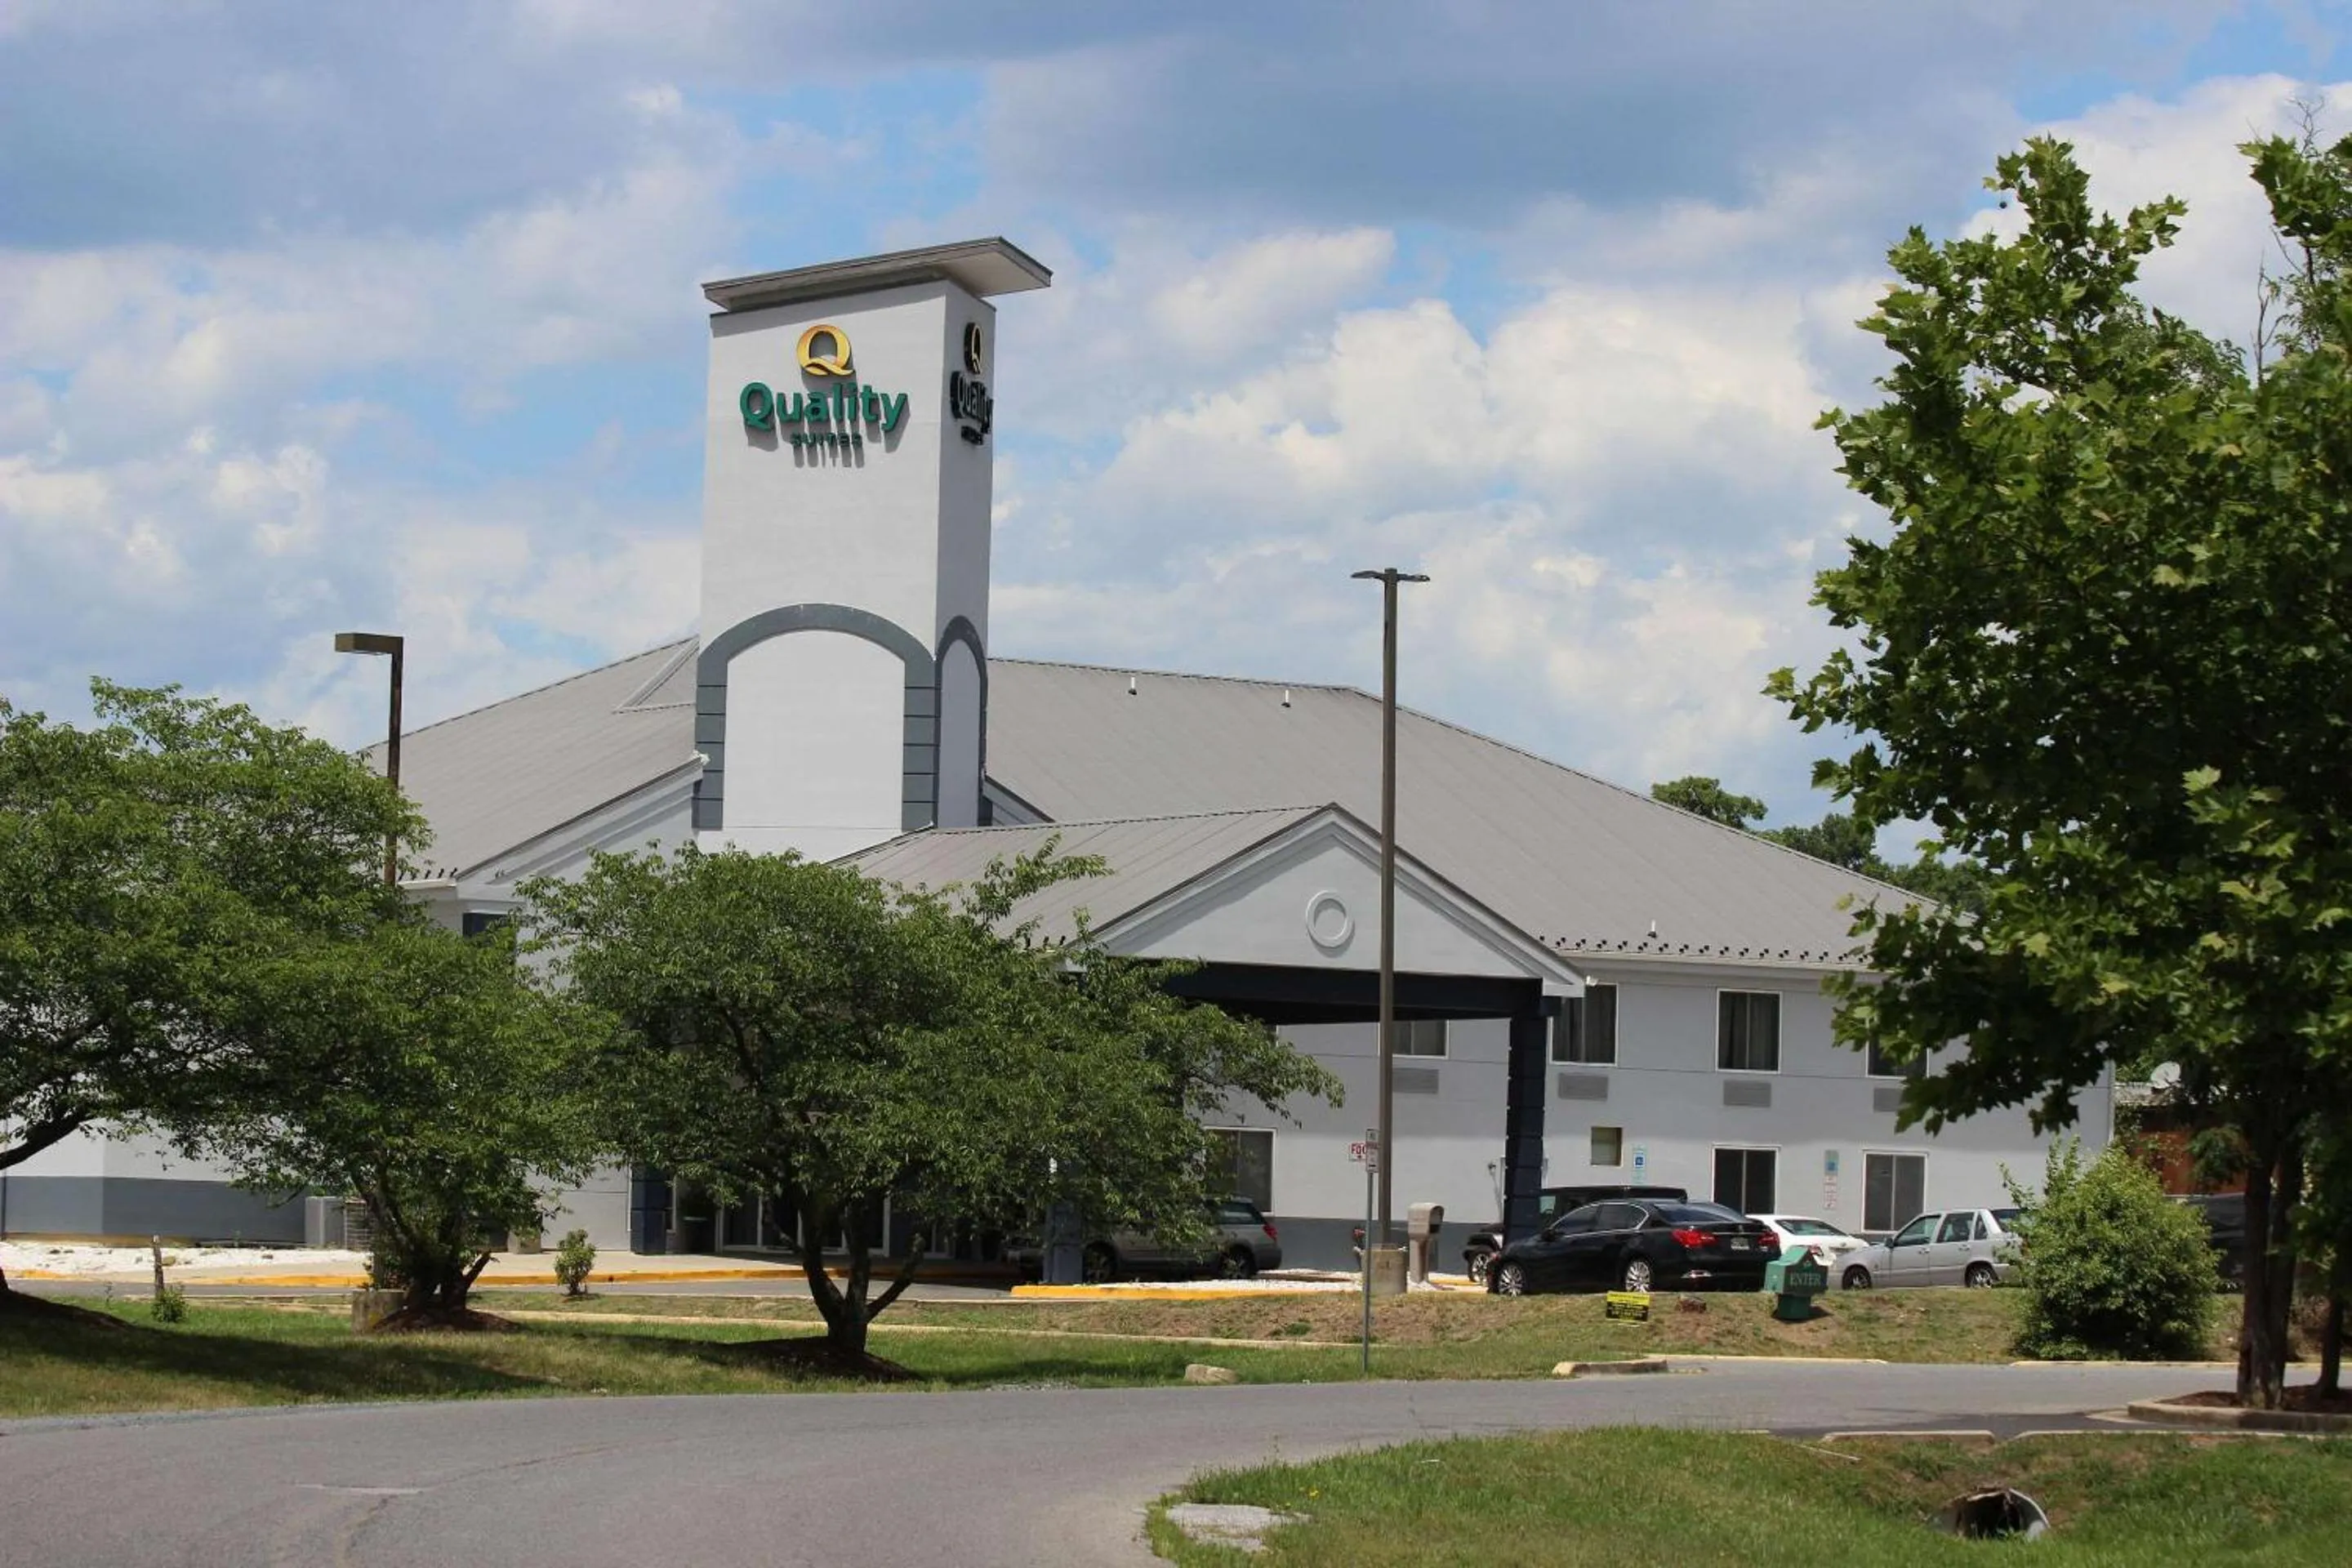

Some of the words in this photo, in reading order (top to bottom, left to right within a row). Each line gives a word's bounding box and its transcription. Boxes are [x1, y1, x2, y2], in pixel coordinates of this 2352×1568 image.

[796, 324, 855, 376] Q
[739, 381, 908, 432] Quality
[1789, 1272, 1821, 1287] ENTER
